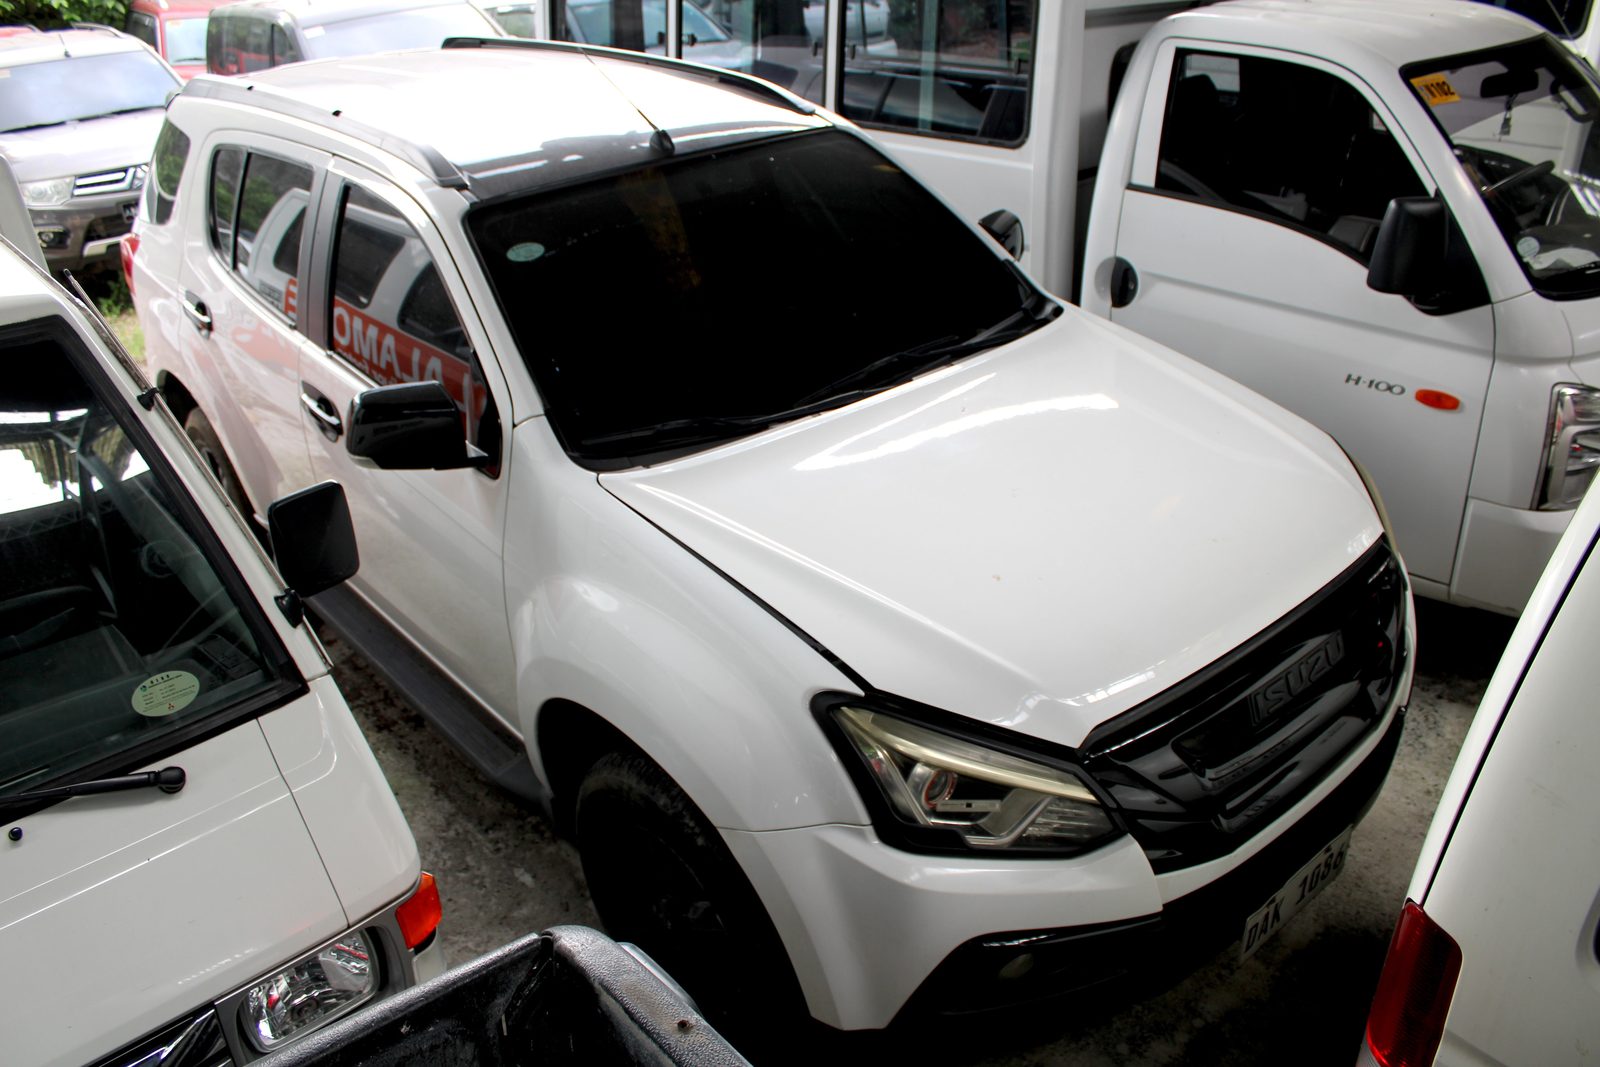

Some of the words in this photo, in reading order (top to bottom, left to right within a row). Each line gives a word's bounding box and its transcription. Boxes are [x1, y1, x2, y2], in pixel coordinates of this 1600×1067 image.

[1344, 373, 1406, 396] H-100
[1249, 634, 1343, 724] ISUZU
[1245, 896, 1285, 953] DAK
